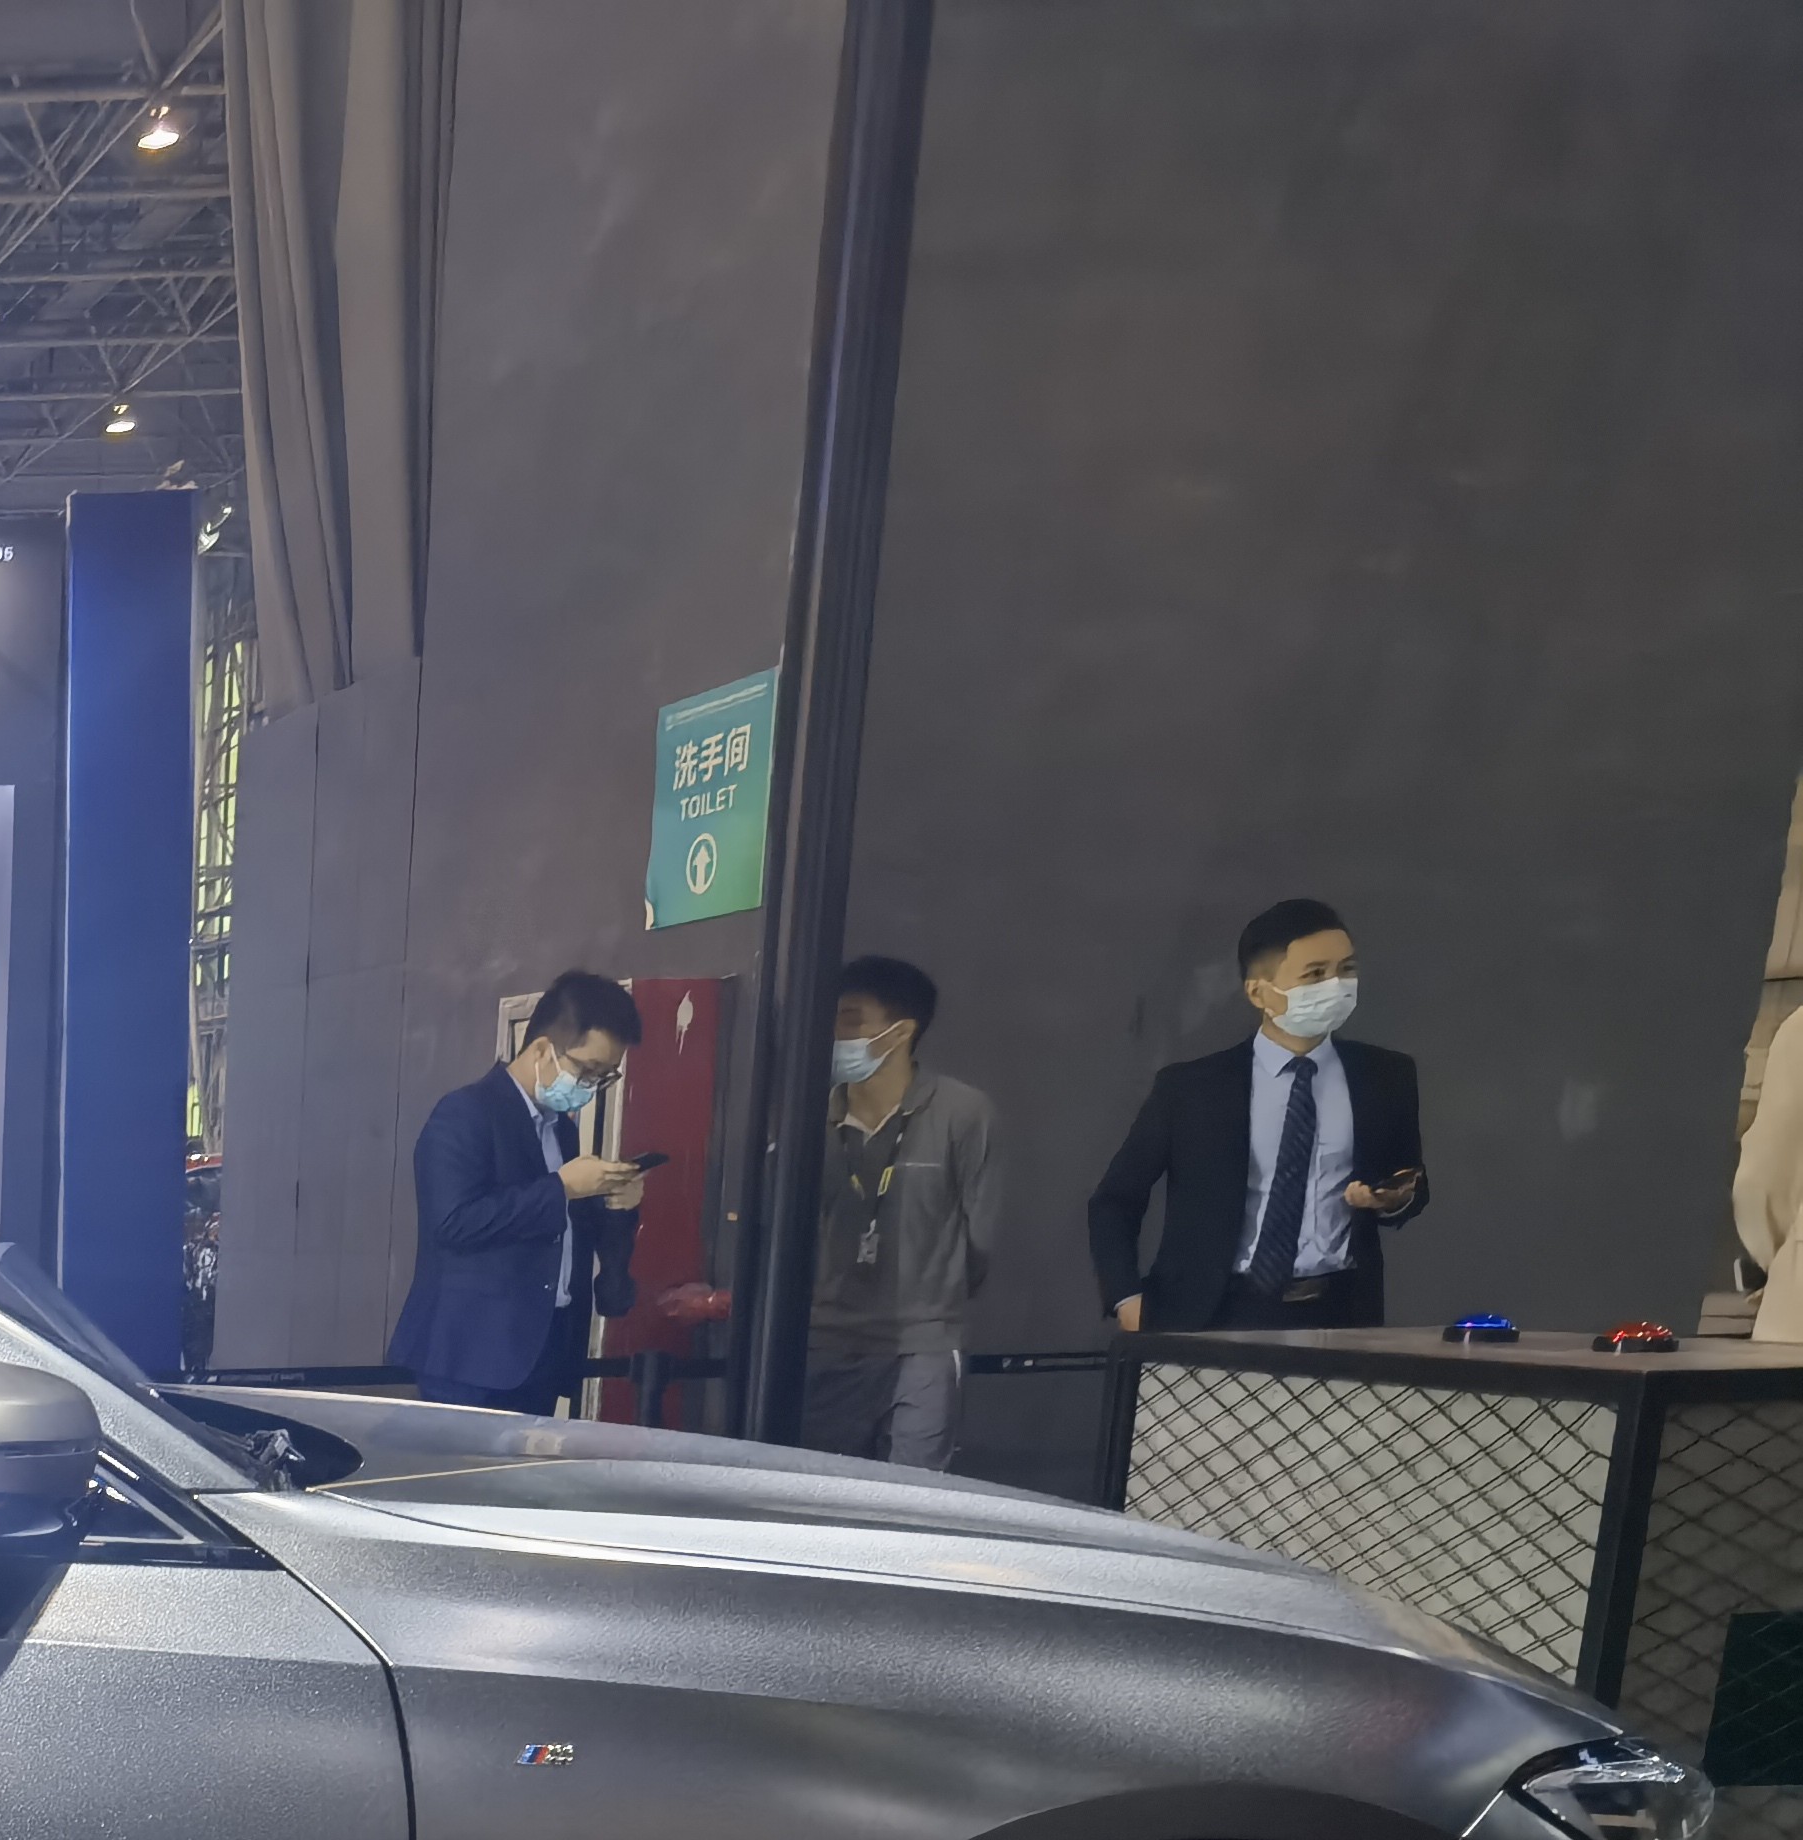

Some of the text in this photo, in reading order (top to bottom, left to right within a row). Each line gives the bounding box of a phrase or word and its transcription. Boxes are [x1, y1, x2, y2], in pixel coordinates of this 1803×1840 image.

[672, 723, 752, 791] 洗手间
[680, 784, 738, 821] TOILET
